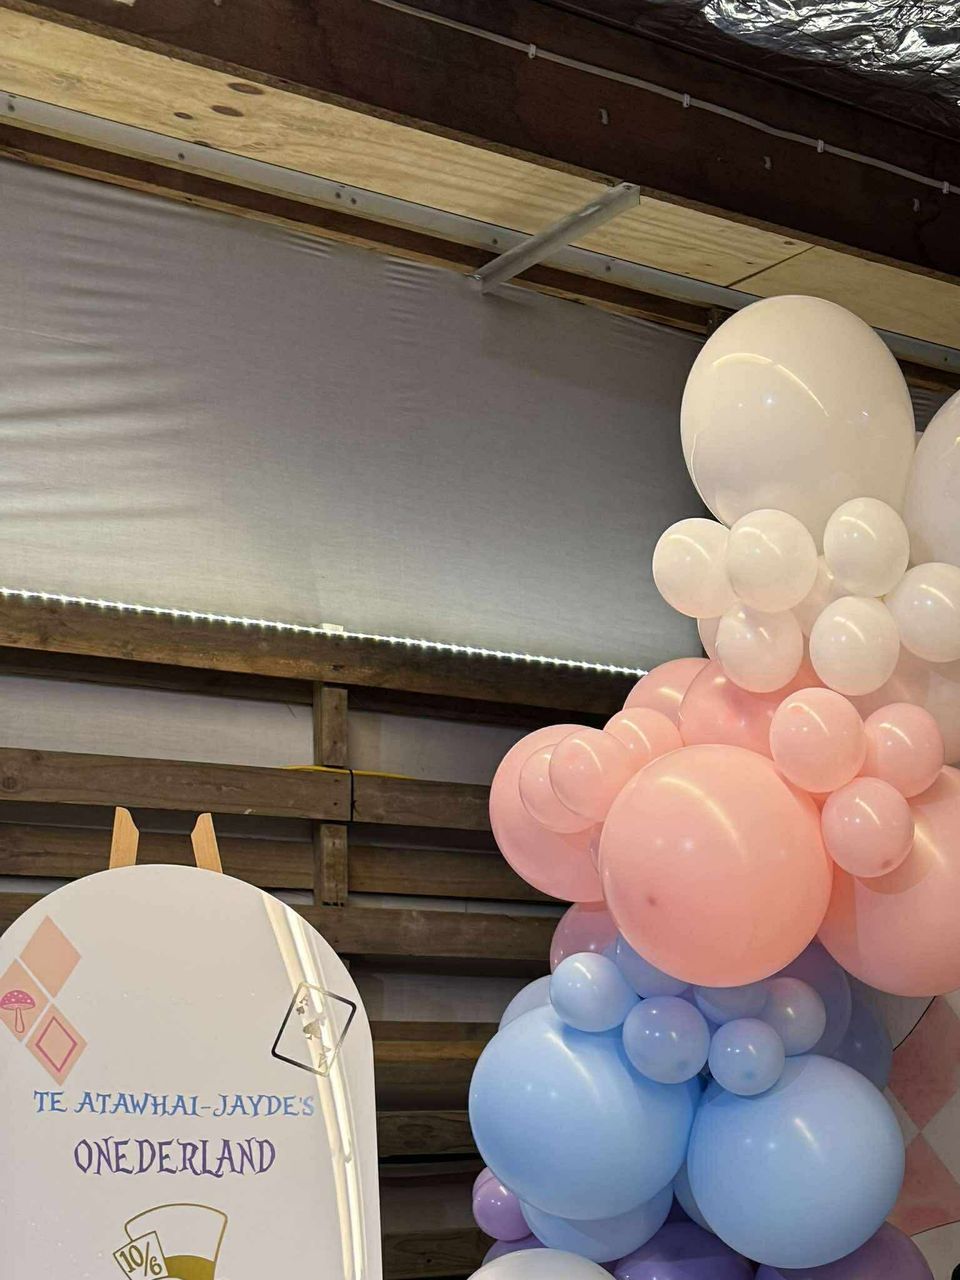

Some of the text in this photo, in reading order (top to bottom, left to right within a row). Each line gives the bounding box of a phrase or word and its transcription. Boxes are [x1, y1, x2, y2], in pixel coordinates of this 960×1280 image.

[34, 1091, 314, 1118] TE ATAWHAI-JAYDE'S
[74, 1136, 276, 1178] ONEDERLAND
[119, 1241, 163, 1277] 10/6
